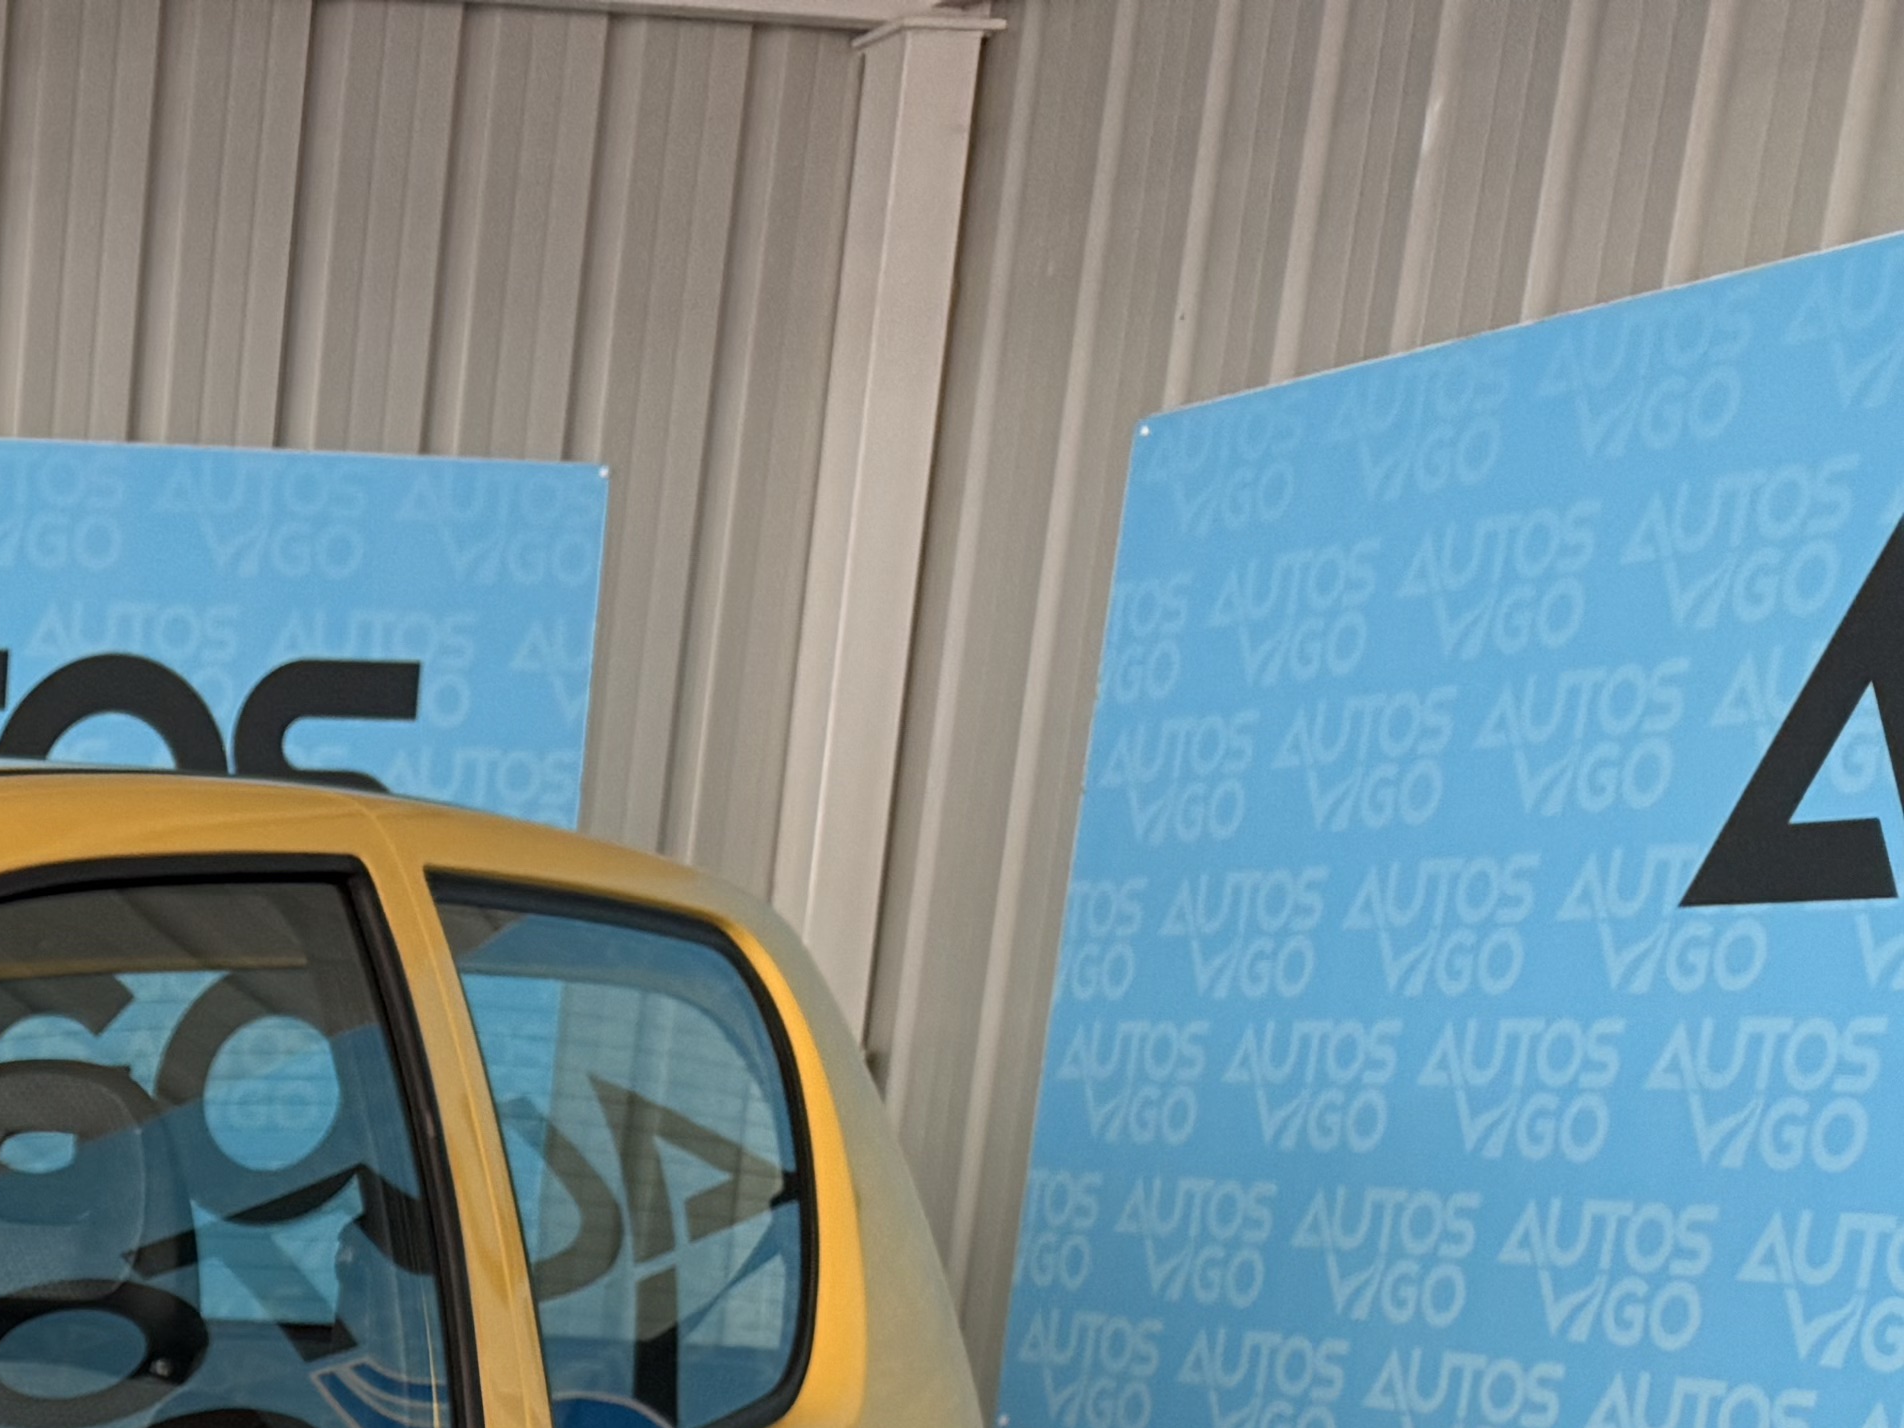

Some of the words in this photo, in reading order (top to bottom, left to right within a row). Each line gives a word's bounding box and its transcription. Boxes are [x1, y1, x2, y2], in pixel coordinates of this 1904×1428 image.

[1620, 444, 1865, 561] AUTOS
[1202, 537, 1380, 631] AUTOS
[1395, 494, 1603, 599] AUTOS
[1270, 683, 1458, 770] AUTOS
[1474, 652, 1693, 748] AUTOS
[1095, 710, 1257, 789] AUTOS
[1157, 868, 1328, 939] AUTOS
[1343, 853, 1541, 930] AUTOS
[1601, 917, 1770, 993] VIGO
[1054, 1023, 1210, 1083] AUTOS
[1223, 1021, 1402, 1085] AUTOS
[1418, 1018, 1627, 1088] AUTOS
[1645, 1015, 1893, 1091] AUTOS
[1083, 1085, 1196, 1146] VIGO
[1257, 1088, 1387, 1153] VIGO
[1457, 1090, 1609, 1161] VIGO
[1691, 1094, 1871, 1171] VIGO
[1114, 1177, 1278, 1243] AUTOS
[1292, 1186, 1482, 1258] AUTOS
[1498, 1197, 1721, 1276] AUTOS
[1145, 1239, 1264, 1307] VIGO
[1328, 1253, 1466, 1327] VIGO
[1540, 1269, 1701, 1350] VIGO
[1015, 1308, 1165, 1377] AUTOS
[1177, 1326, 1350, 1401] AUTOS
[1364, 1347, 1565, 1428] AUTOS
